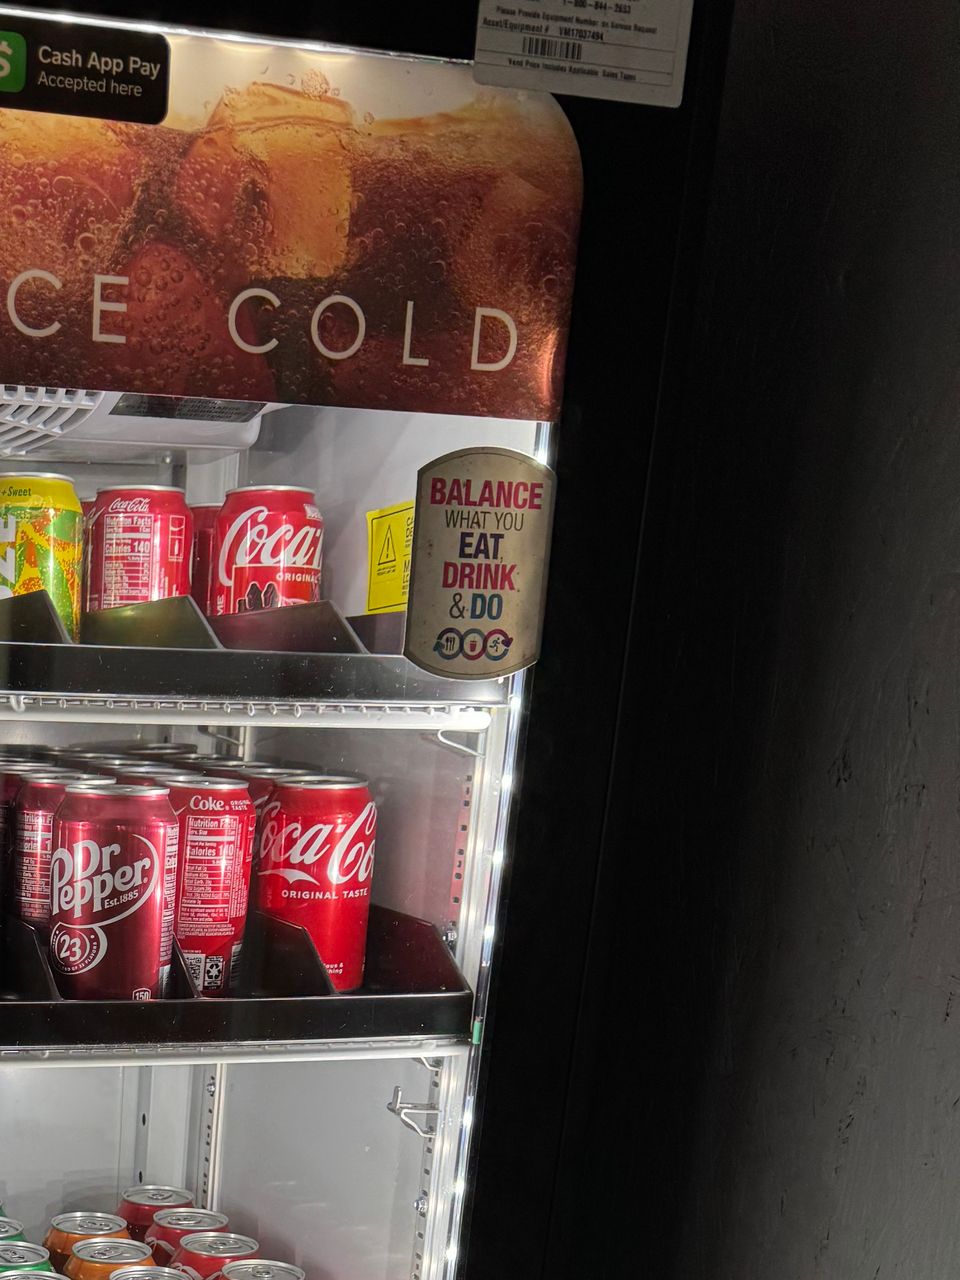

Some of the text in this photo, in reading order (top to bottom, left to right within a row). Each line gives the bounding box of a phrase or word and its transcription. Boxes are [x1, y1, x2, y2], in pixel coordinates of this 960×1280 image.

[38, 45, 161, 80] Cash App Pay
[37, 71, 143, 97] Accepted here
[227, 287, 519, 372] COLD
[7, 486, 32, 497] Sweet
[430, 477, 544, 511] BALANCE
[445, 509, 525, 532] WHAT YOU
[458, 532, 505, 562] EAT,
[442, 561, 518, 592] DRINK
[449, 592, 503, 620] & DO
[189, 795, 225, 811] Coke
[189, 818, 219, 828] Nutrition
[73, 840, 121, 877] Dr
[188, 846, 217, 857] Calories
[104, 889, 139, 909] Est.1885
[281, 887, 368, 900] ORIGINAL TASTE
[59, 934, 82, 962] 23
